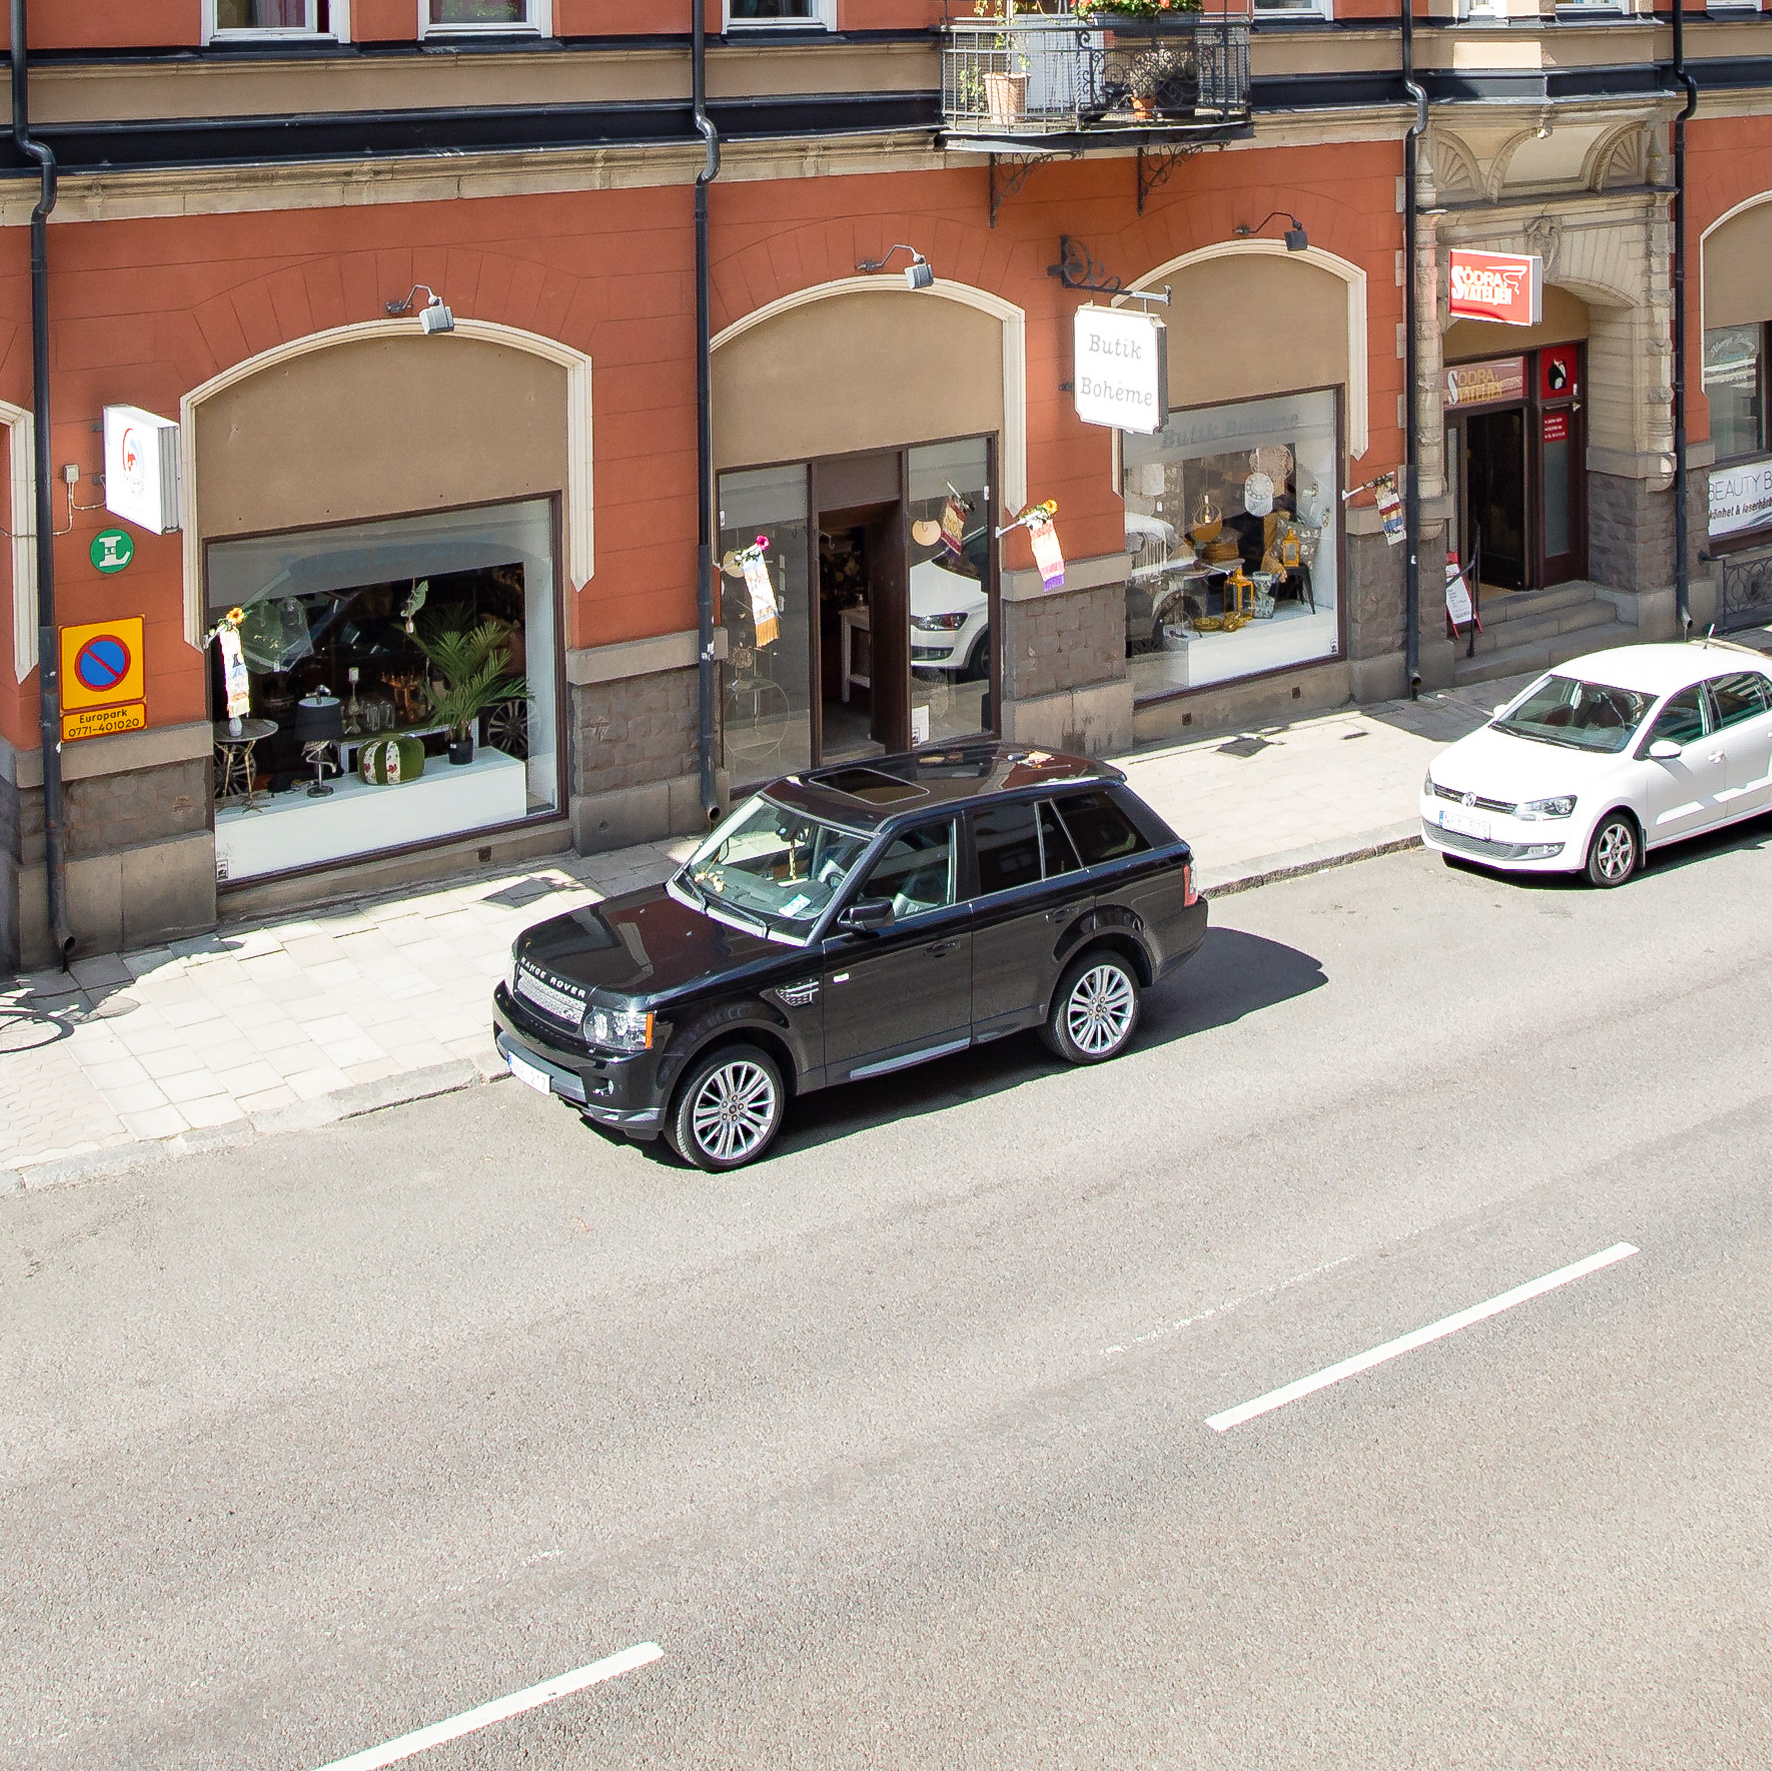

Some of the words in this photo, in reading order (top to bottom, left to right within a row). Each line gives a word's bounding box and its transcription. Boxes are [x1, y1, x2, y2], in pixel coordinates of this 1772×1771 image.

[1089, 333, 1142, 359] Butik
[1080, 376, 1153, 406] Bohème
[1709, 473, 1761, 502] BEAUTY
[68, 718, 140, 737] 0771-401020
[80, 709, 127, 724] Europark
[520, 956, 547, 979] RANGE
[550, 976, 586, 998] ROVER
